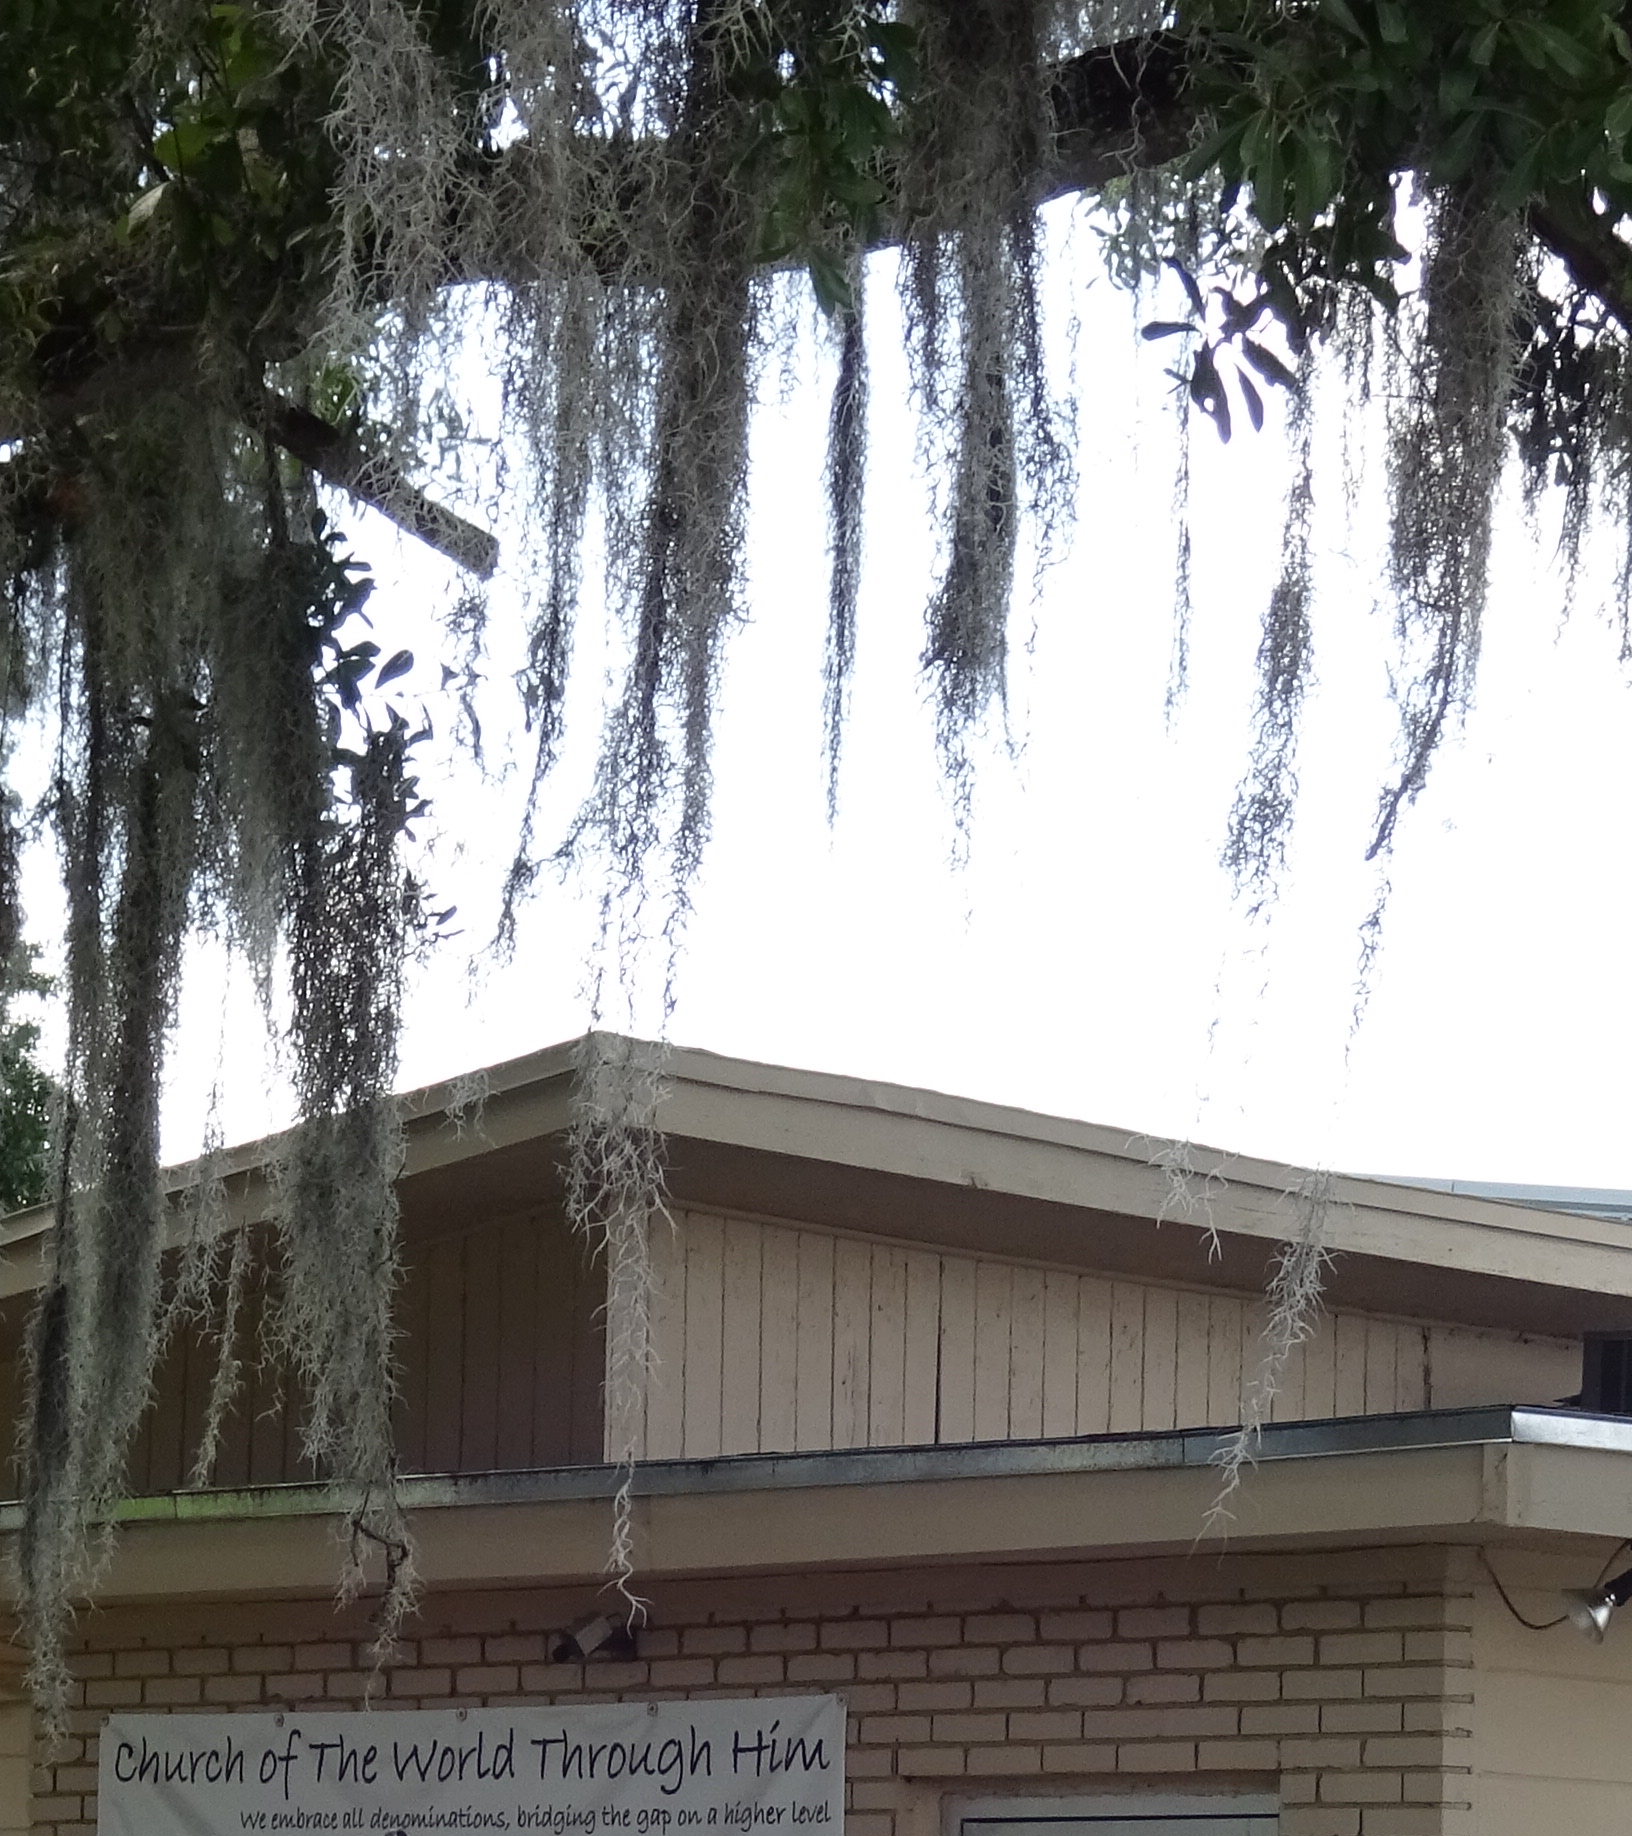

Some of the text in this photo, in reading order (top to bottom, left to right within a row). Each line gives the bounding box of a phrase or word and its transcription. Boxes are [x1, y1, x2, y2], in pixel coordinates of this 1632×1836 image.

[115, 1720, 830, 1801] Church of The World Through Him
[240, 1800, 832, 1835] We embrace all denominations, bridging the gap on a higher level
